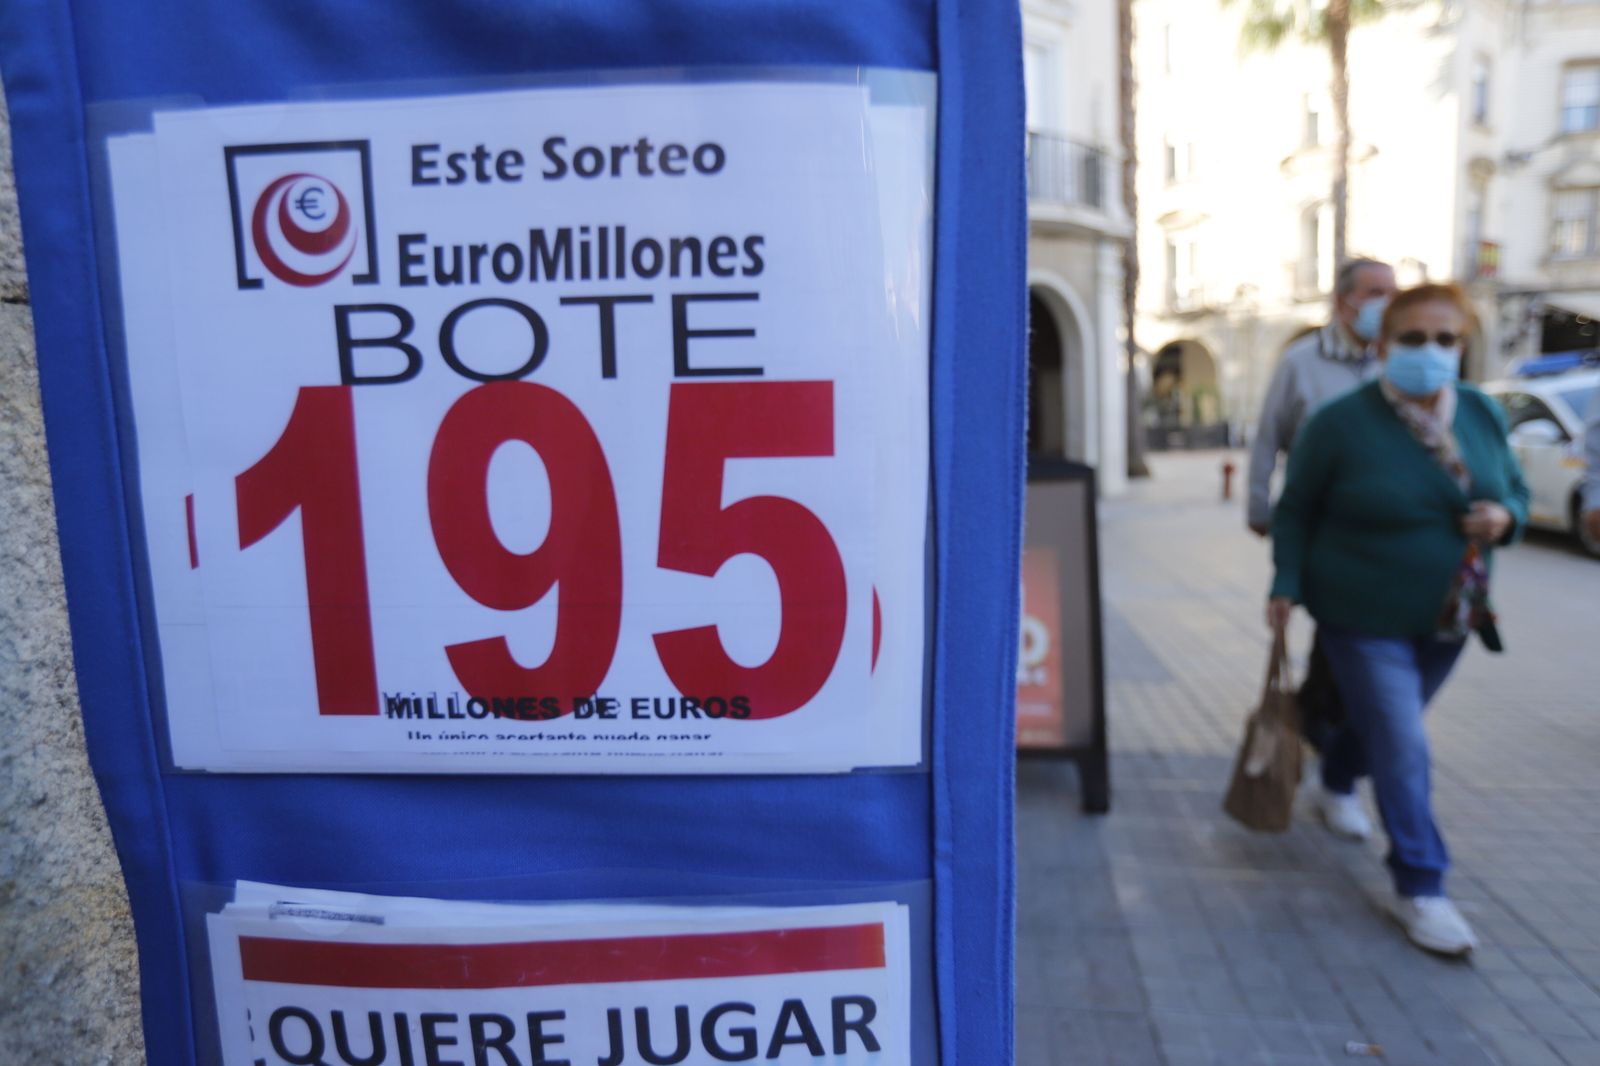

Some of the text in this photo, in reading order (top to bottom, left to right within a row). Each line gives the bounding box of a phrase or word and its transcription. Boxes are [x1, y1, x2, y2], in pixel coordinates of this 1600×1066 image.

[410, 136, 727, 187] Este Sorteo
[398, 225, 765, 286] EuroMillones
[334, 291, 765, 386] BOTE
[235, 380, 848, 721] 195
[385, 694, 752, 721] MILLONES DE EUROS
[597, 994, 882, 1066] JUGAR
